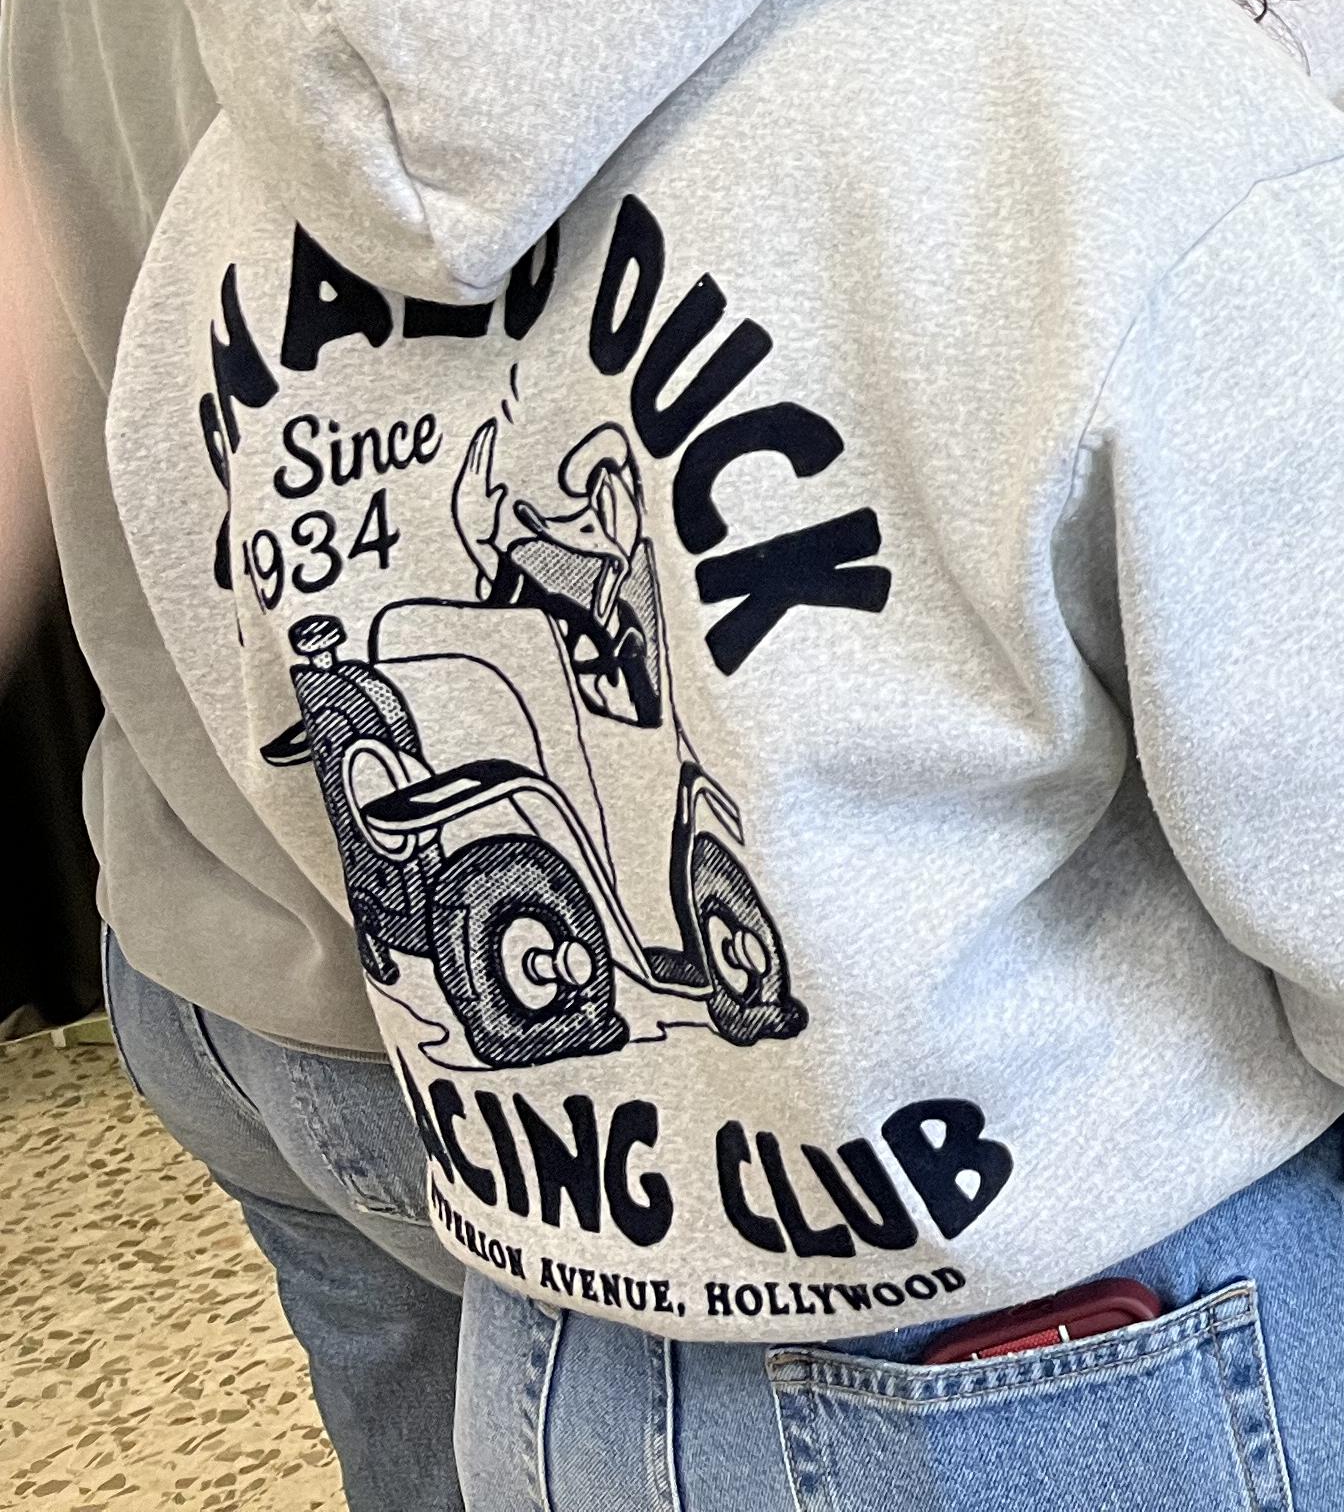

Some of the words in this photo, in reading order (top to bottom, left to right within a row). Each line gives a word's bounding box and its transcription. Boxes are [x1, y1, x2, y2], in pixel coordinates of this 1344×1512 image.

[273, 413, 443, 500] Since
[588, 193, 891, 677] DUCK
[394, 1045, 674, 1247] ACING
[716, 1098, 1014, 1258] CLUB
[540, 1257, 687, 1317] AVENUE,
[704, 1266, 967, 1317] HOLLYWOOD
